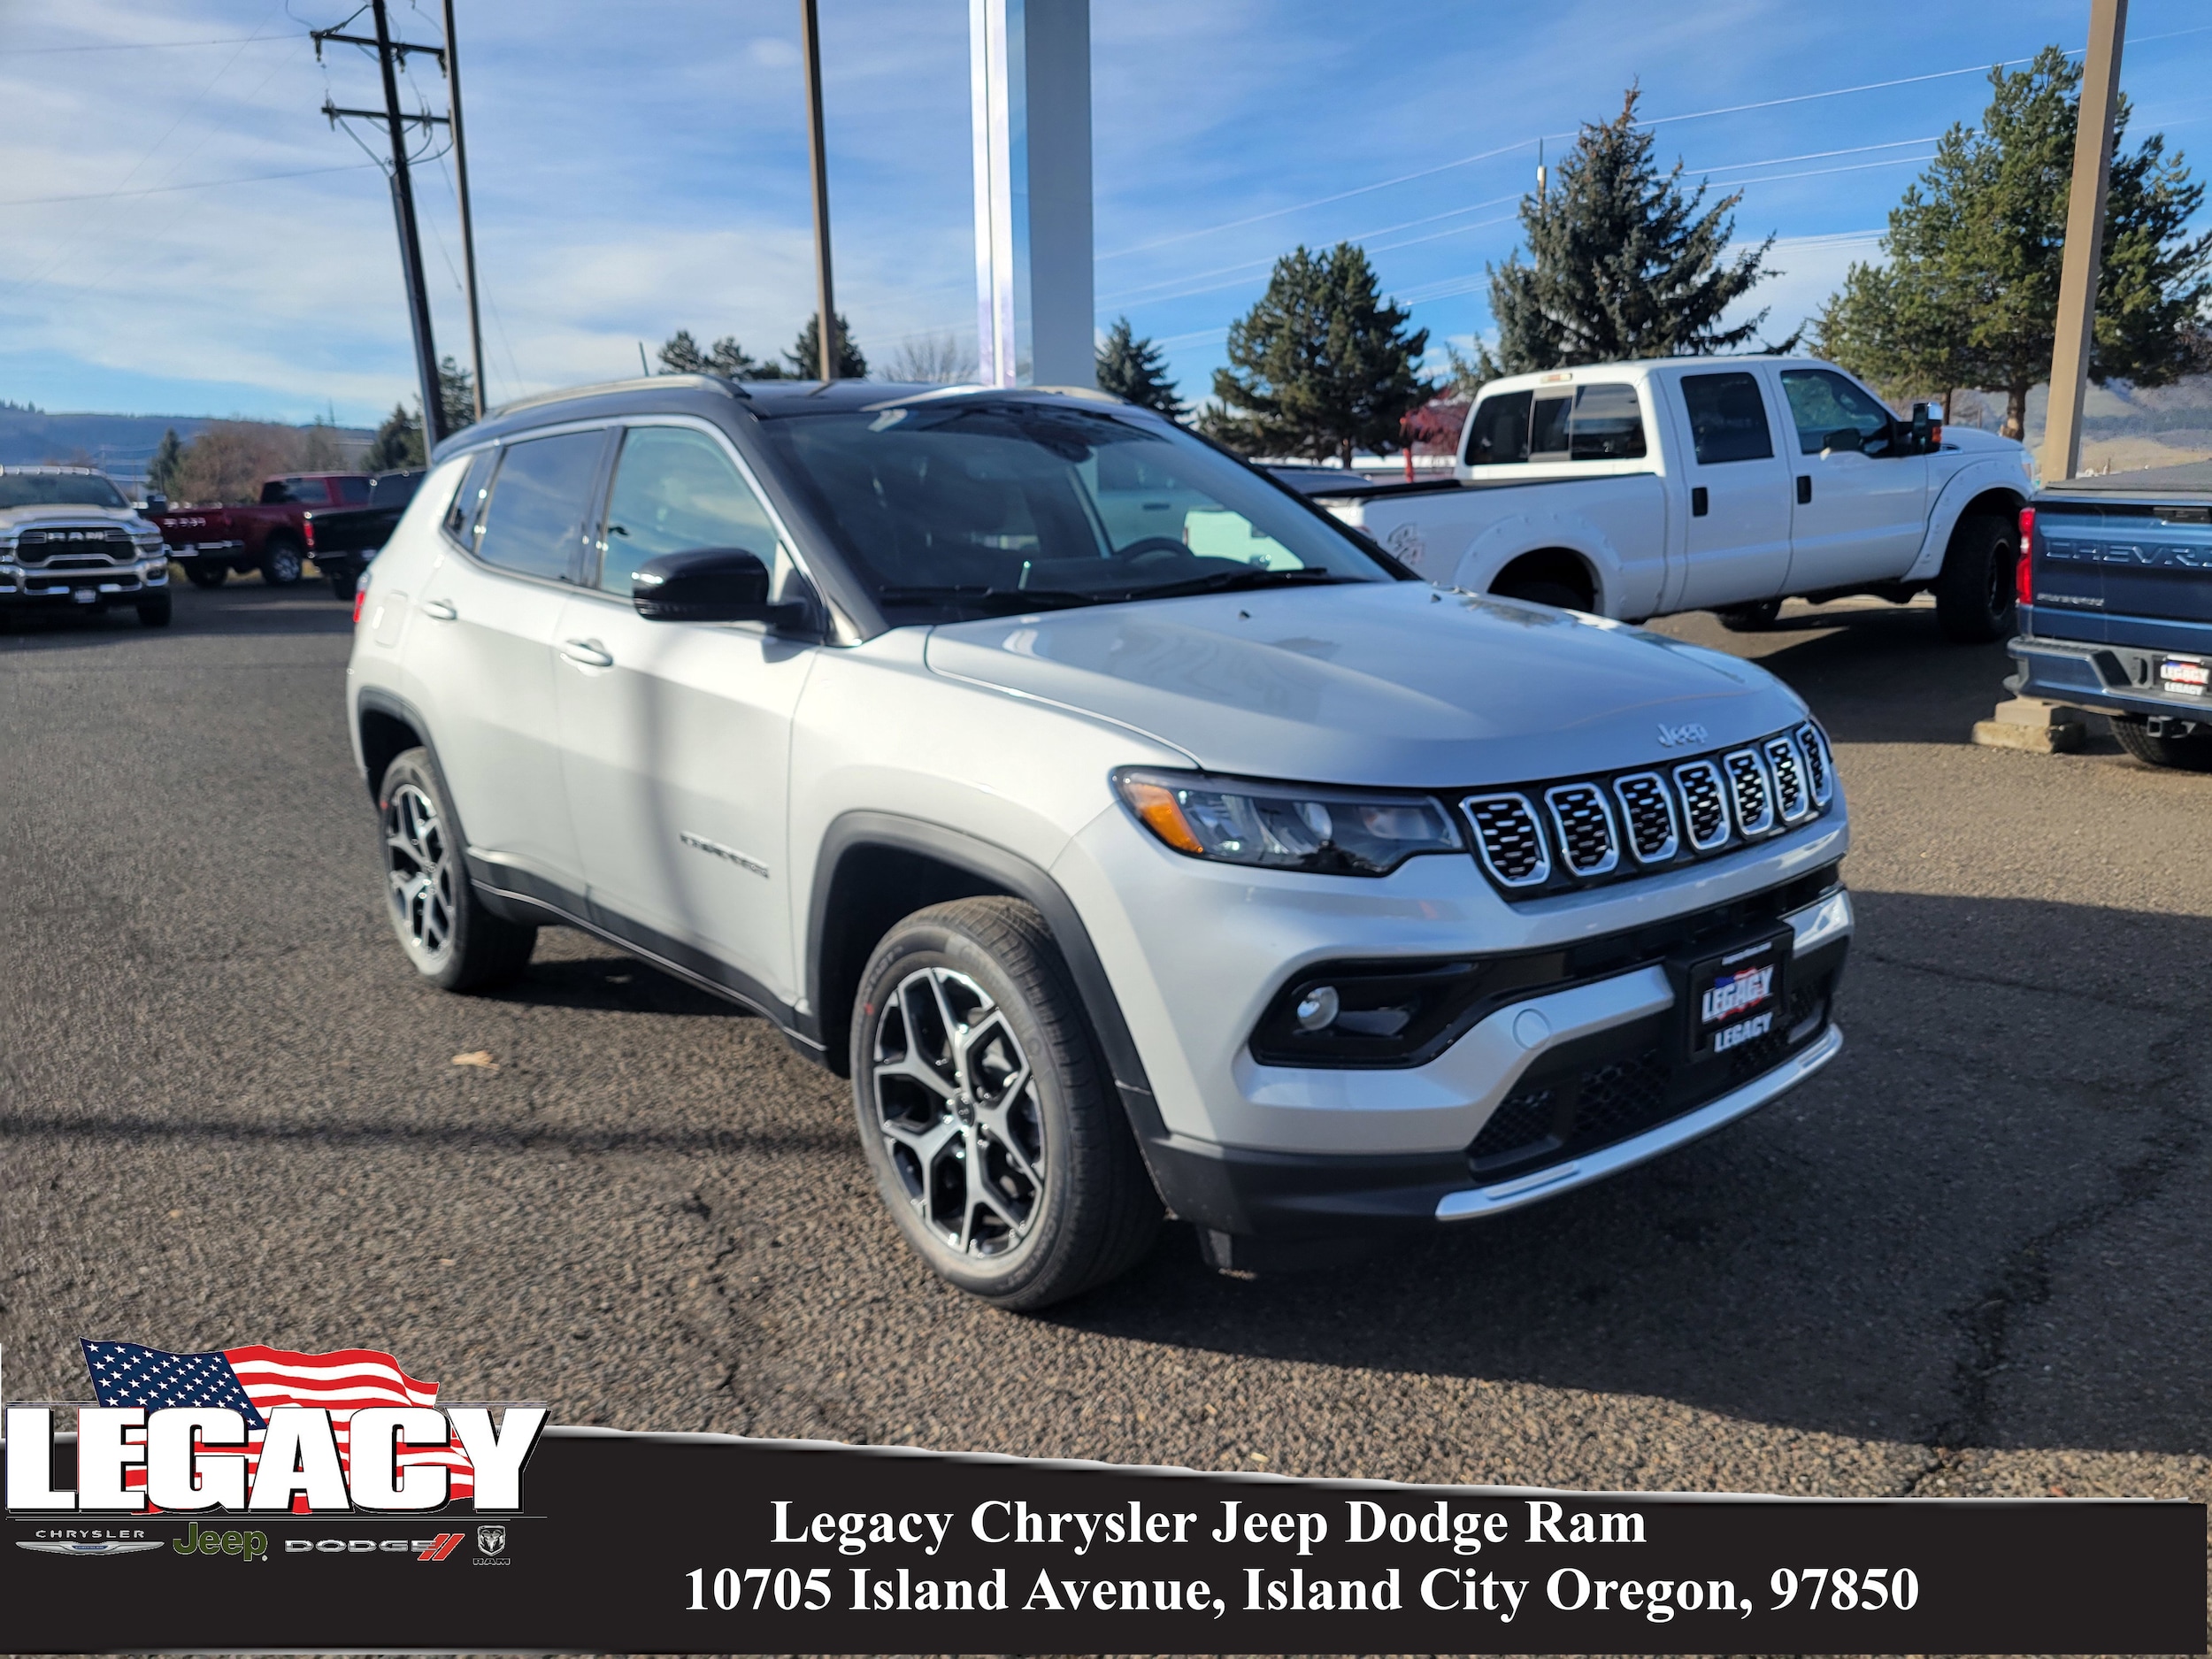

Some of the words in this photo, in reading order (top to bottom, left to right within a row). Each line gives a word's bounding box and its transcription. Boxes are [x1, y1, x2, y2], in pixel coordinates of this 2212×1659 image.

[2160, 664, 2209, 684] LEGACY
[1657, 723, 1709, 748] Jeep
[1701, 964, 1774, 1025] LEGACY
[1714, 1011, 1773, 1053] LEGACY
